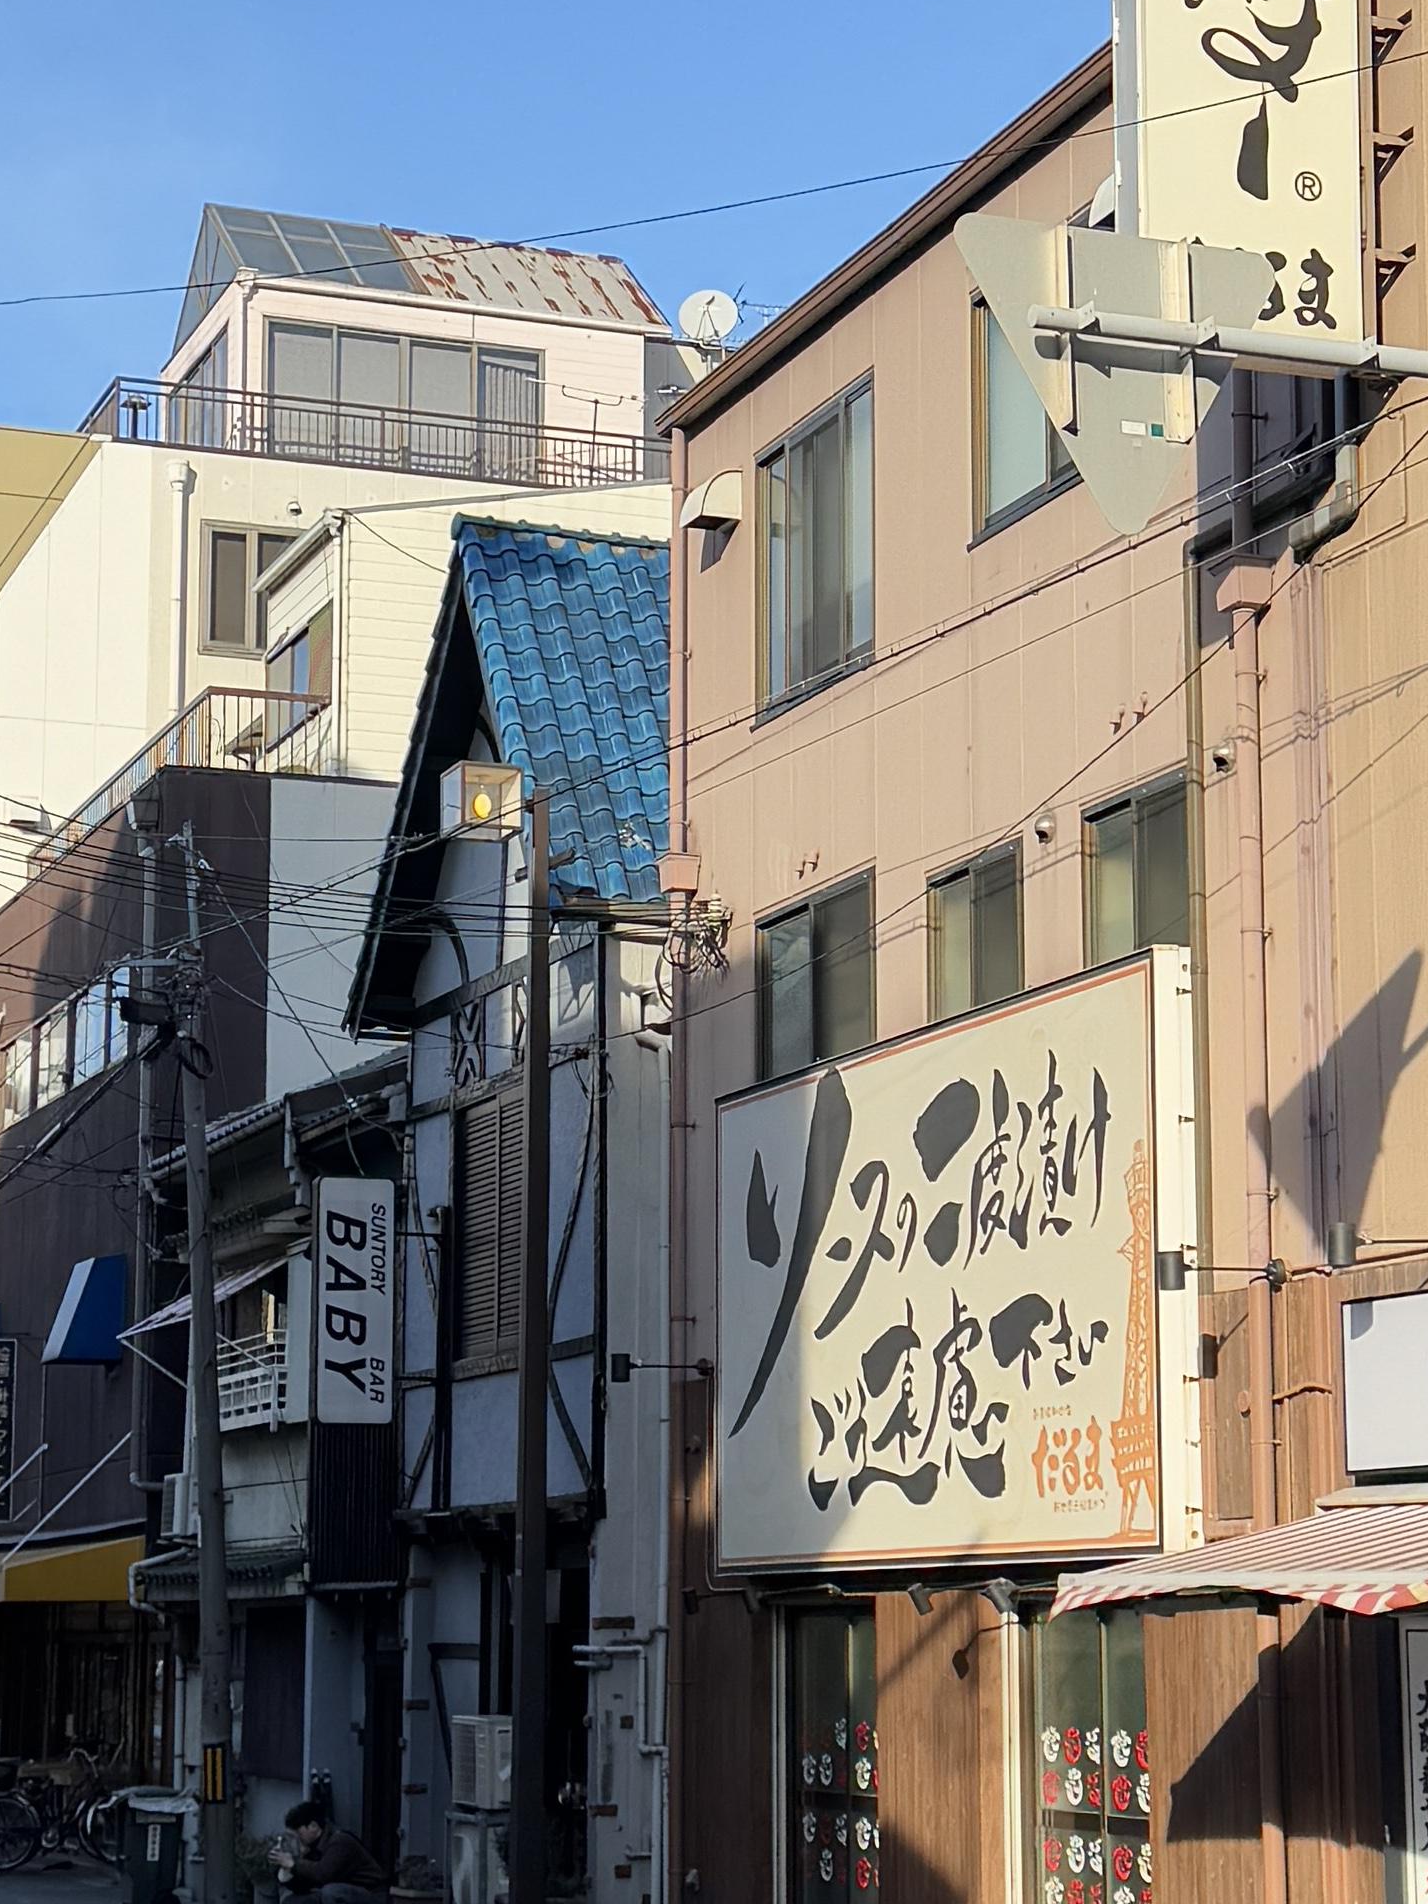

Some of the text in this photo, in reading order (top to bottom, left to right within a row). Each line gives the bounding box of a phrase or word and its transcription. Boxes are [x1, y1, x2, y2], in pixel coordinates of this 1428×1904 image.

[324, 1209, 367, 1394] BABY
[369, 1202, 386, 1404] SUNTORY BAR
[1031, 1415, 1103, 1498] だるま
